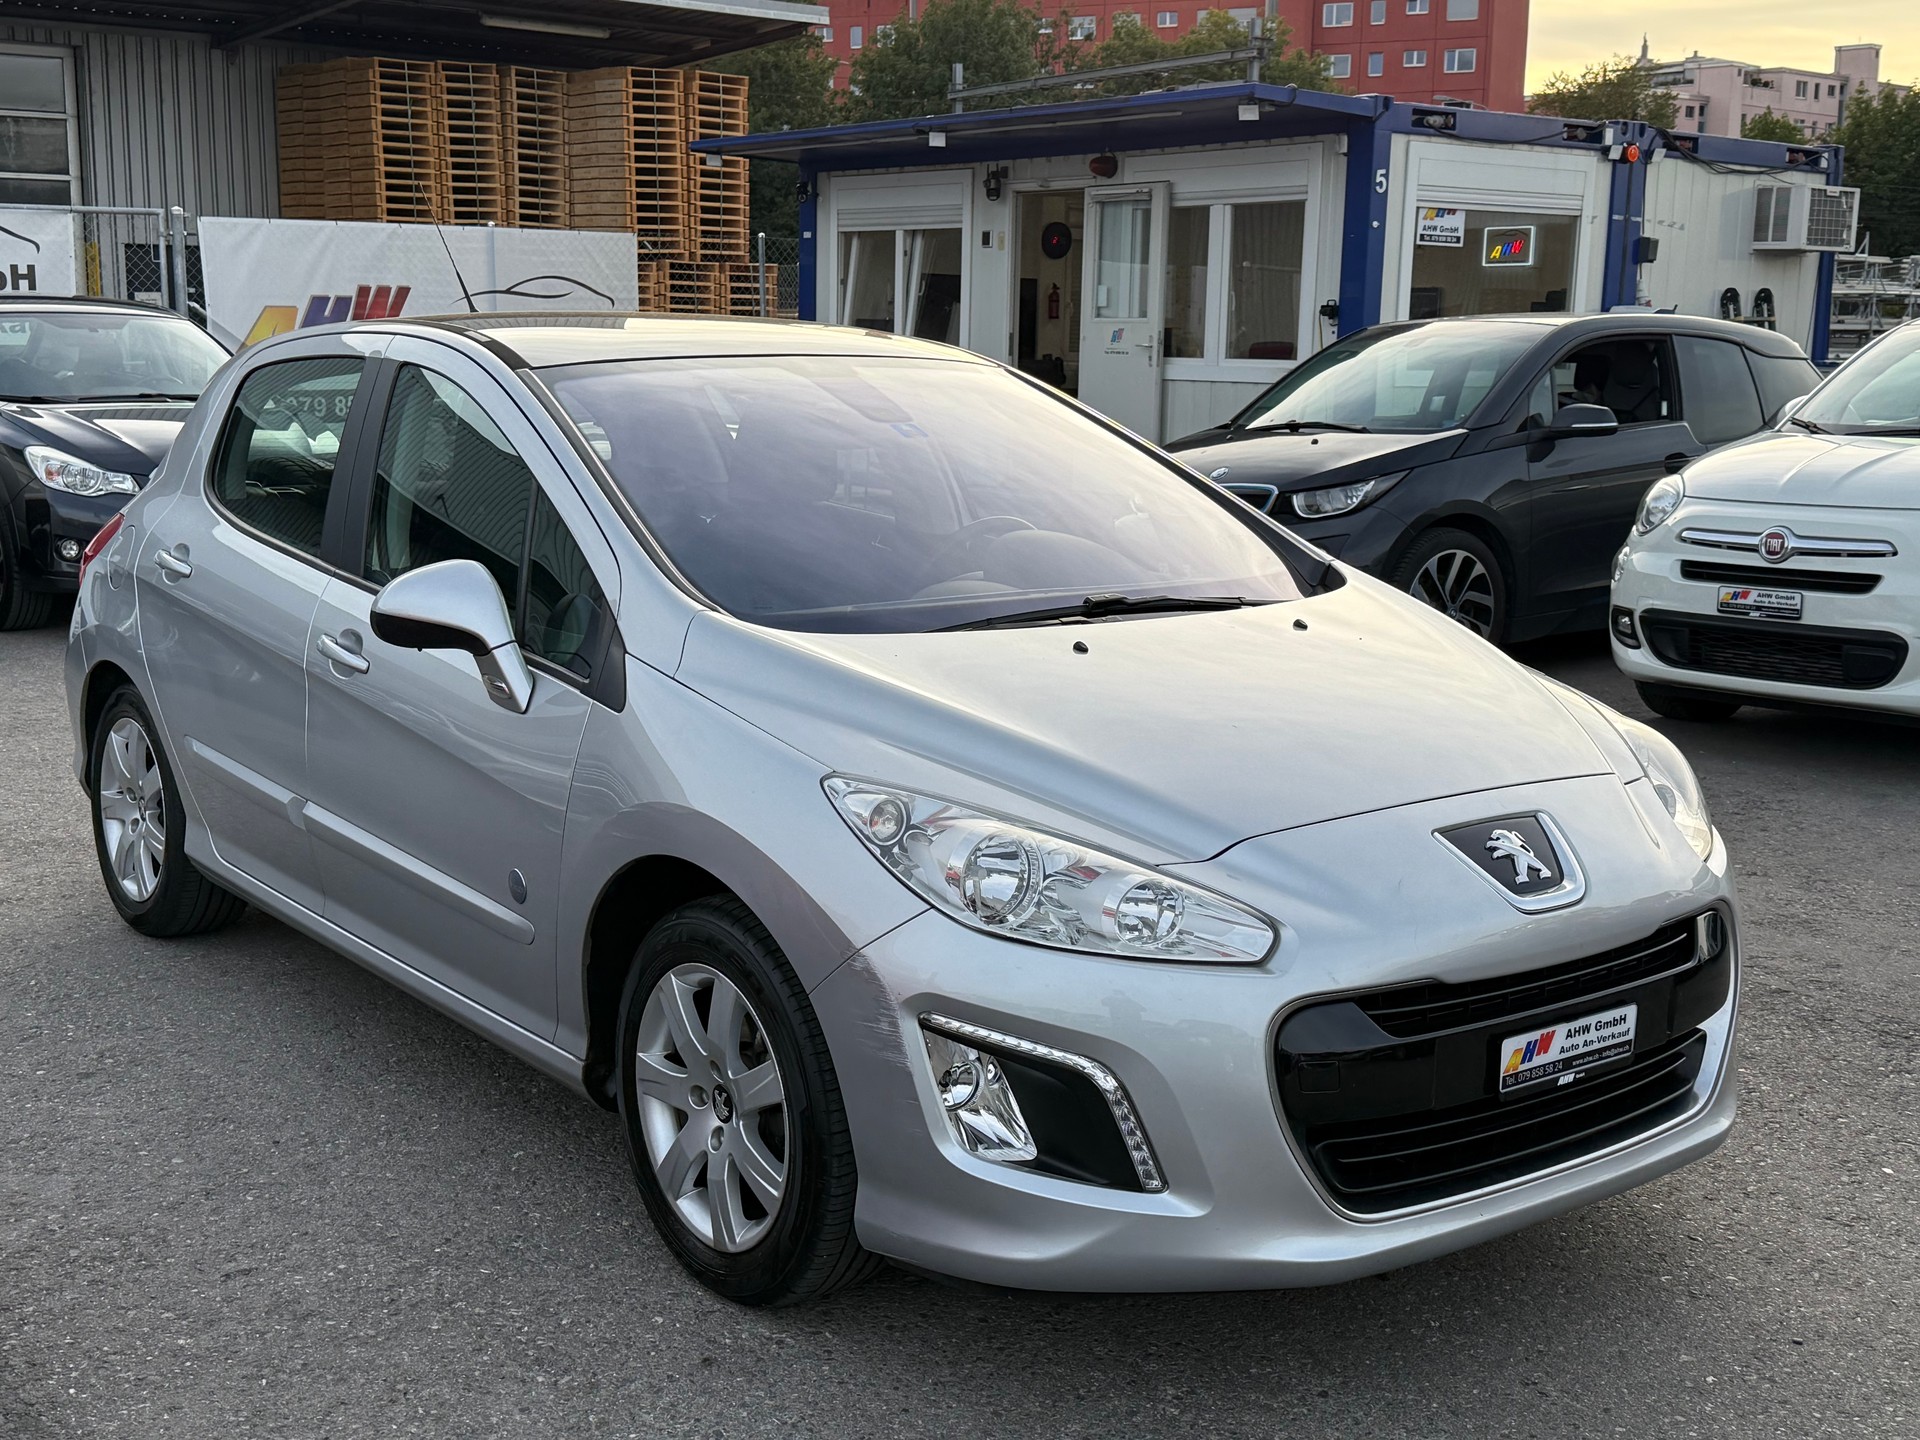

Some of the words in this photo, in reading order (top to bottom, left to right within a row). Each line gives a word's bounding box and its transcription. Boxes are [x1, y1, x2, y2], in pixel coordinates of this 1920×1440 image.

[1375, 169, 1387, 193] 5
[1439, 225, 1459, 234] GmbH
[1490, 239, 1524, 259] AHW
[1766, 538, 1783, 552] FIAT
[1720, 589, 1752, 602] AHW
[1565, 1023, 1591, 1040] AHW
[1594, 1013, 1627, 1031] GmbH
[1503, 1030, 1557, 1074] AHW
[1559, 1043, 1580, 1055] Auto
[1582, 1027, 1631, 1048] An-Verkauf
[1505, 1074, 1516, 1086] Tel.
[1518, 1071, 1531, 1082] 079
[1531, 1067, 1544, 1079] 858
[1545, 1064, 1554, 1075] 58
[1554, 1061, 1563, 1072] 24
[1557, 1072, 1575, 1086] AHW
